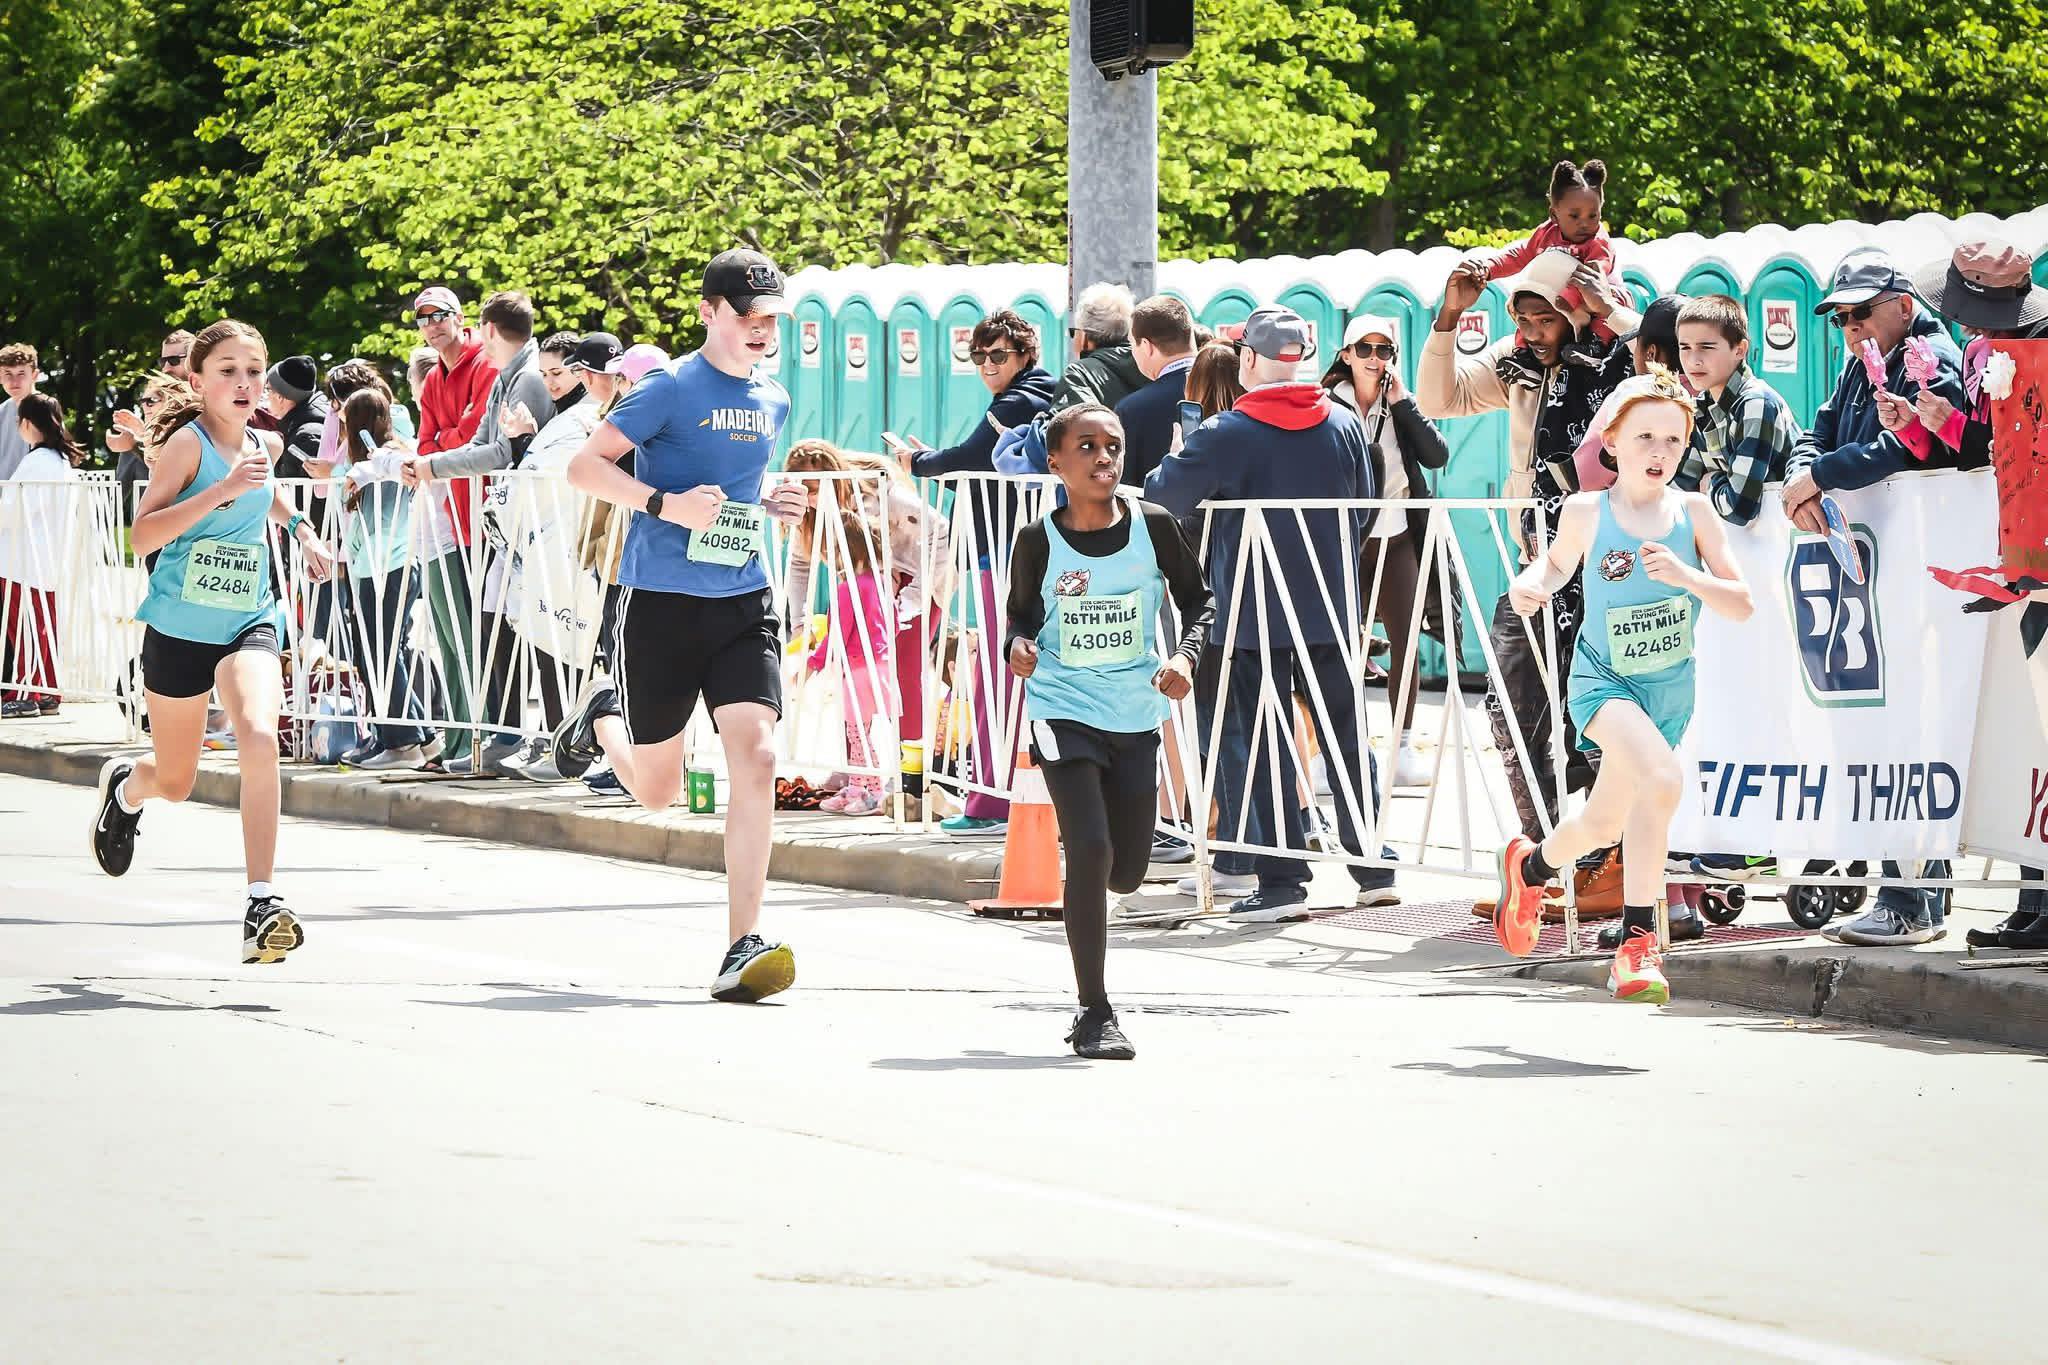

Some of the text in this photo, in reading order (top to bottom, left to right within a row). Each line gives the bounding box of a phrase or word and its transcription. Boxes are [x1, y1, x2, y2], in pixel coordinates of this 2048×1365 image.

[729, 433, 757, 442] SOCCER
[720, 508, 737, 516] LYING
[716, 515, 760, 531] TH MILE
[700, 532, 750, 552] 40982
[194, 553, 258, 572] 26TH MILE
[197, 574, 250, 595] 42484
[1063, 607, 1137, 625] 26TH MILE
[1613, 609, 1687, 636] 26TH MILE
[1632, 607, 1670, 621] FLYING PIG
[1070, 630, 1133, 650] 43098
[1624, 632, 1681, 659] 42485
[1847, 761, 1961, 822] THIRD
